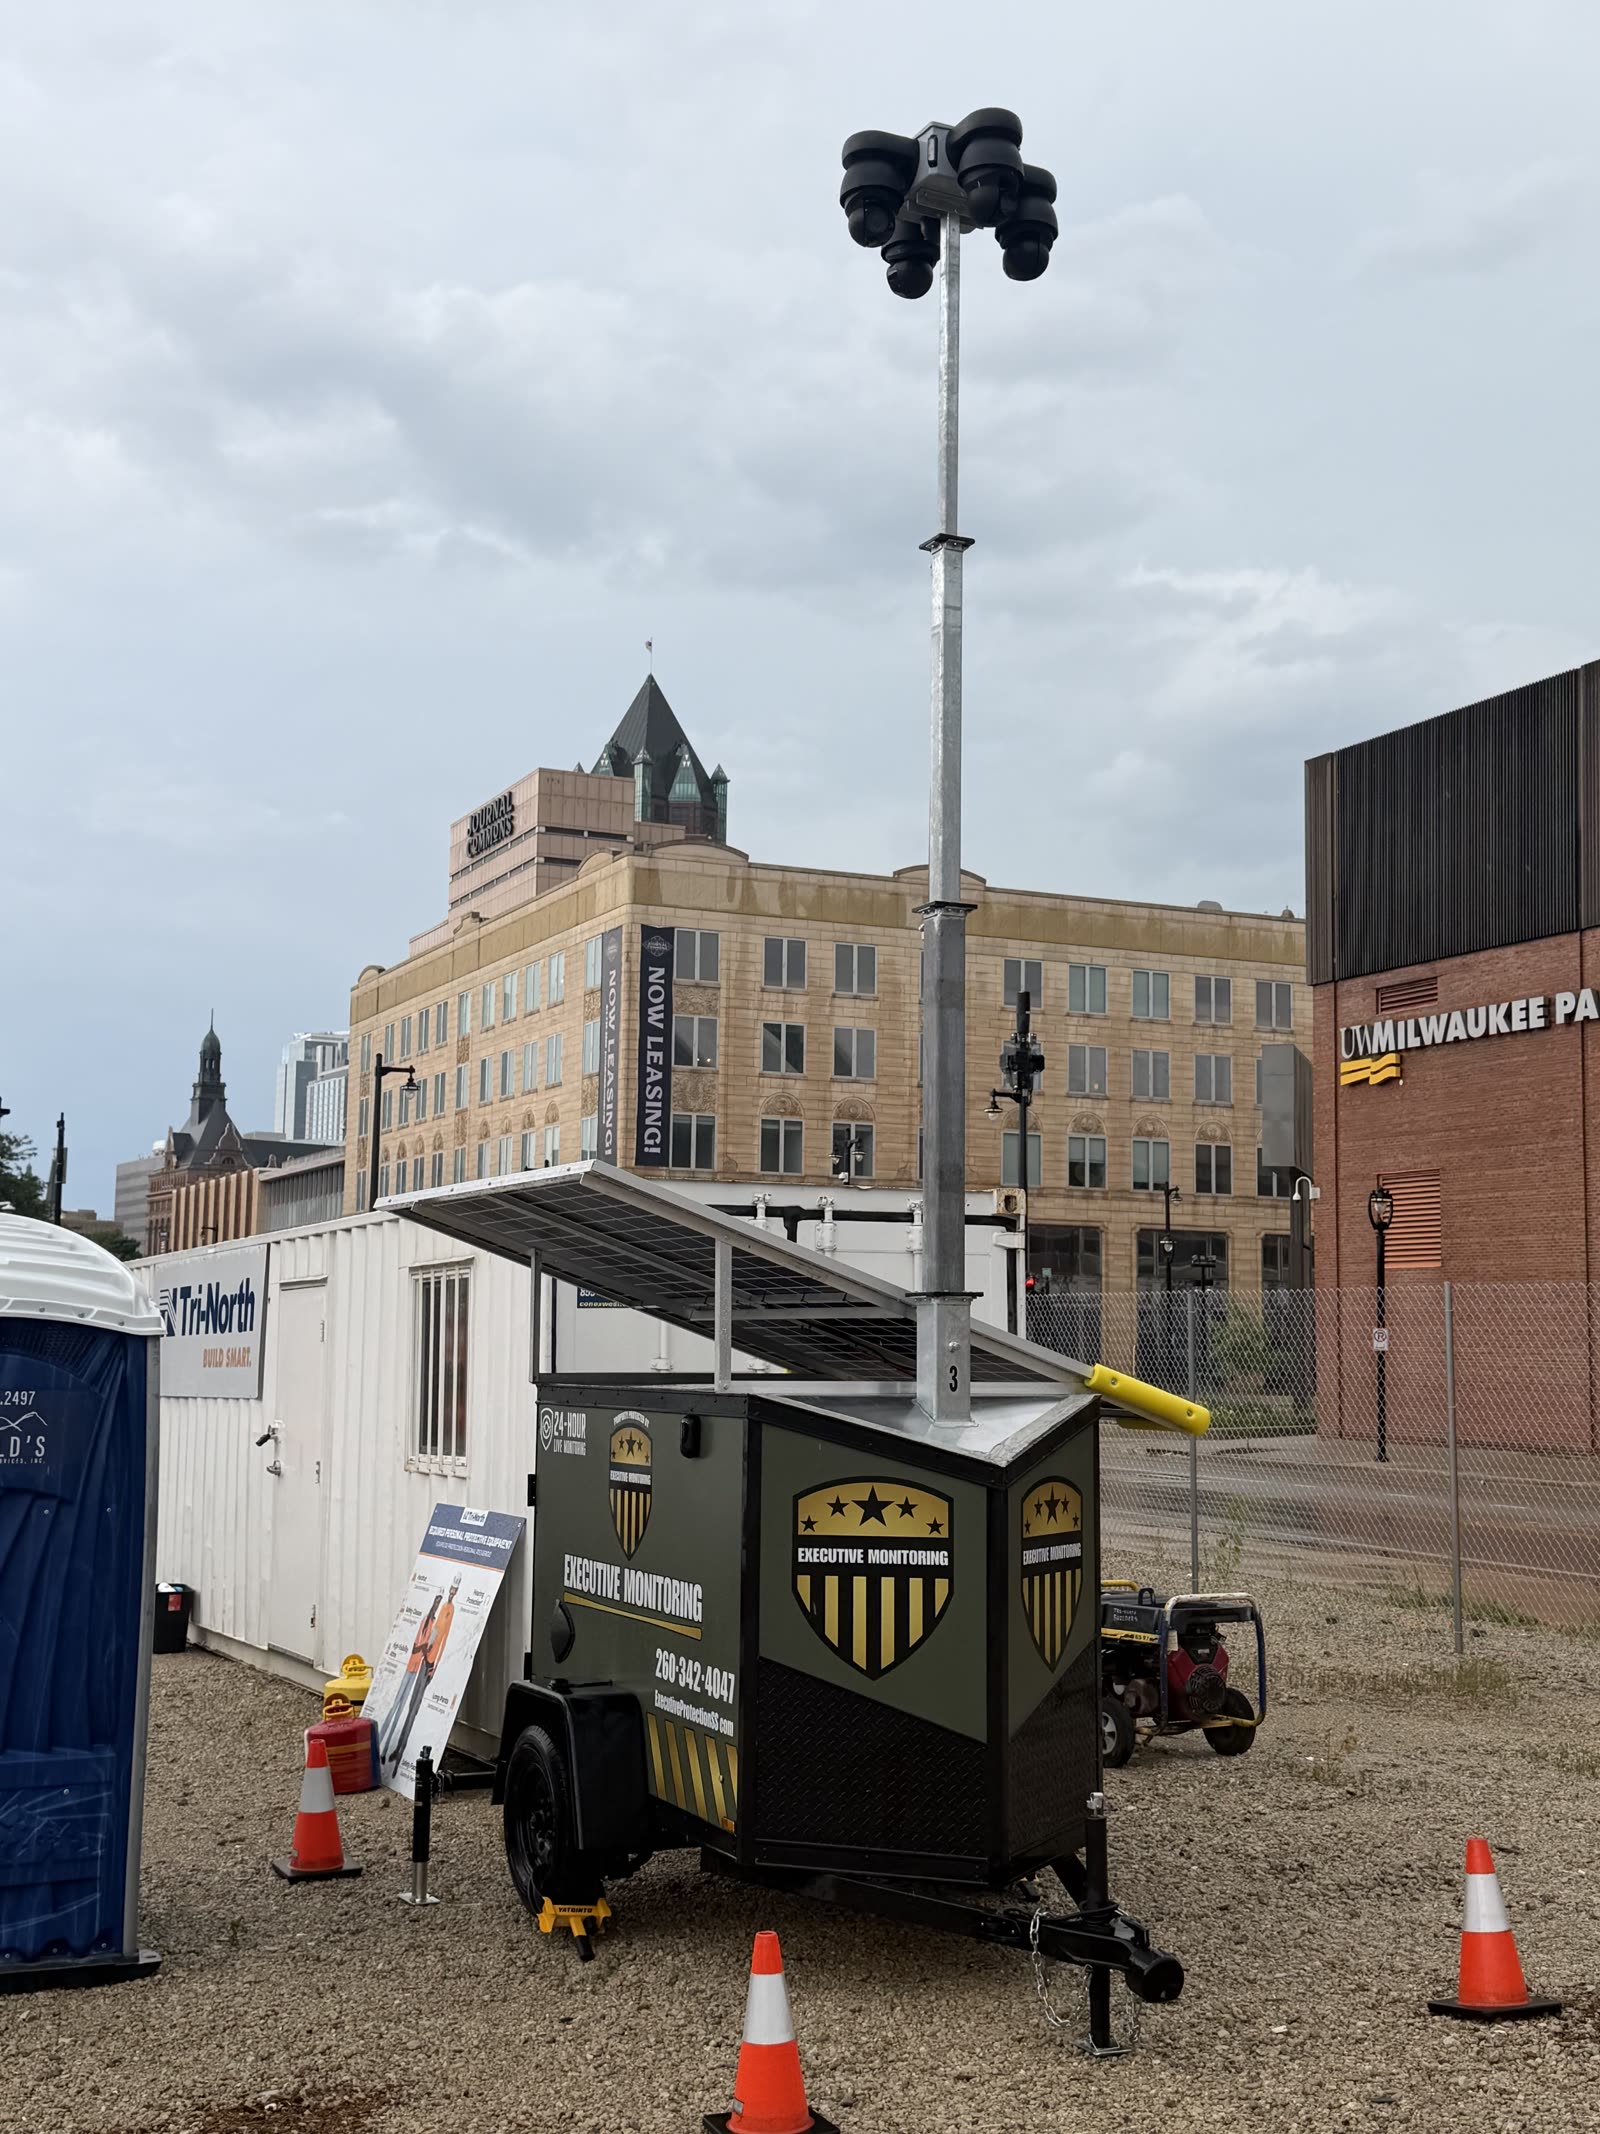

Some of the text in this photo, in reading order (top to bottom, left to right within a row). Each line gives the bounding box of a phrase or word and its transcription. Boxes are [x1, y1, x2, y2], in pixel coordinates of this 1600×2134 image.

[467, 791, 514, 837] JOURNAL
[466, 815, 514, 858] COMMONS
[608, 969, 617, 1030] NOW
[647, 966, 666, 1030] NOW
[604, 1038, 615, 1155] LEASING!
[644, 1035, 664, 1154] LEASING!
[180, 1277, 255, 1336] Tri-North
[203, 1348, 224, 1368] BUILD
[949, 1365, 958, 1393] 3
[0, 1435, 46, 1457] D'S
[553, 1411, 587, 1439] 24-HOUR
[553, 1439, 563, 1453] LIVE
[797, 1547, 949, 1567] EXECUTIVE MONITORING
[1022, 1543, 1082, 1566] EXECUTIVE MONITORING
[563, 1553, 703, 1623] EXECUTIVE MONITORING
